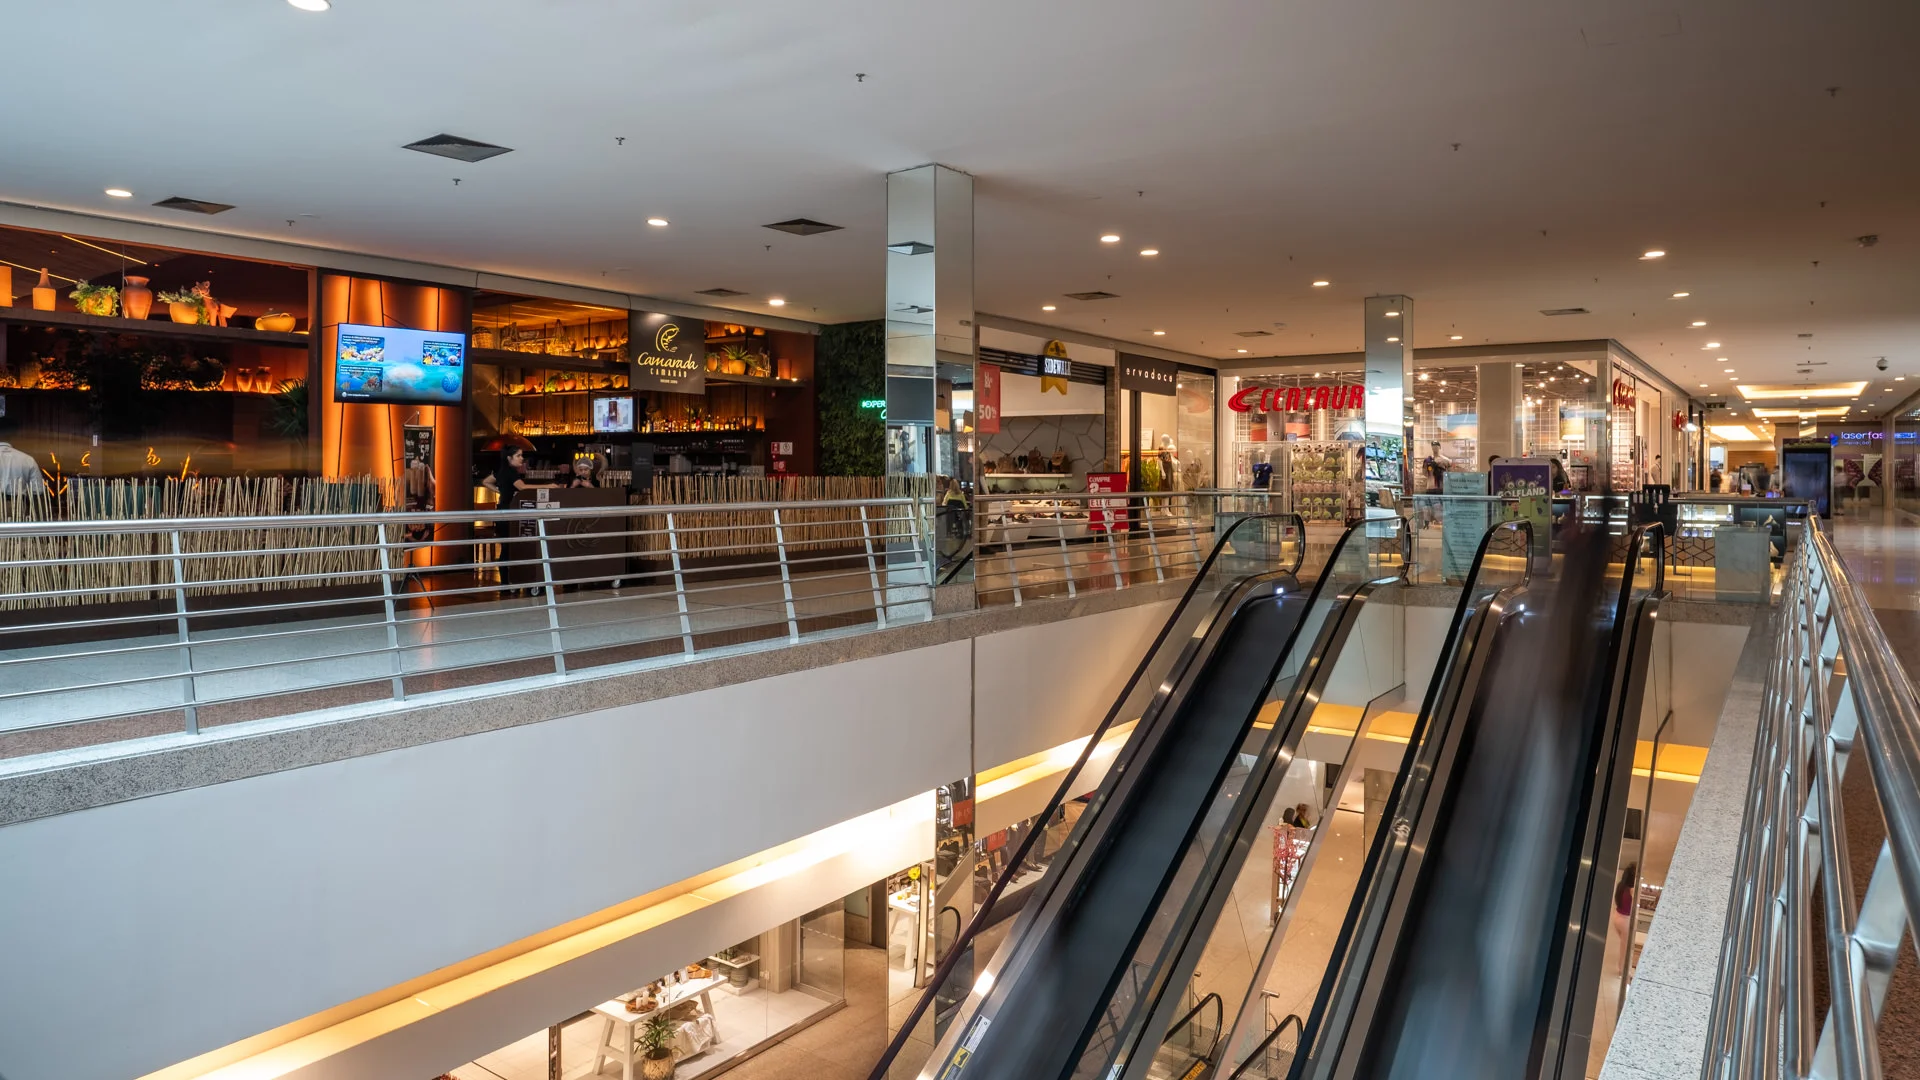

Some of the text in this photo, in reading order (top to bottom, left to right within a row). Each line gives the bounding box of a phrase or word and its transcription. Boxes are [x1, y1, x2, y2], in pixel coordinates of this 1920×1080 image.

[638, 352, 699, 370] Camarada
[1044, 357, 1072, 376] SIDEWALK
[650, 367, 687, 378] CAMARÃO
[1126, 367, 1173, 383] ervadoce
[1259, 385, 1366, 412] CENTAUR
[1841, 431, 1885, 440] laserfas
[1498, 487, 1546, 497] GOLFLAND
